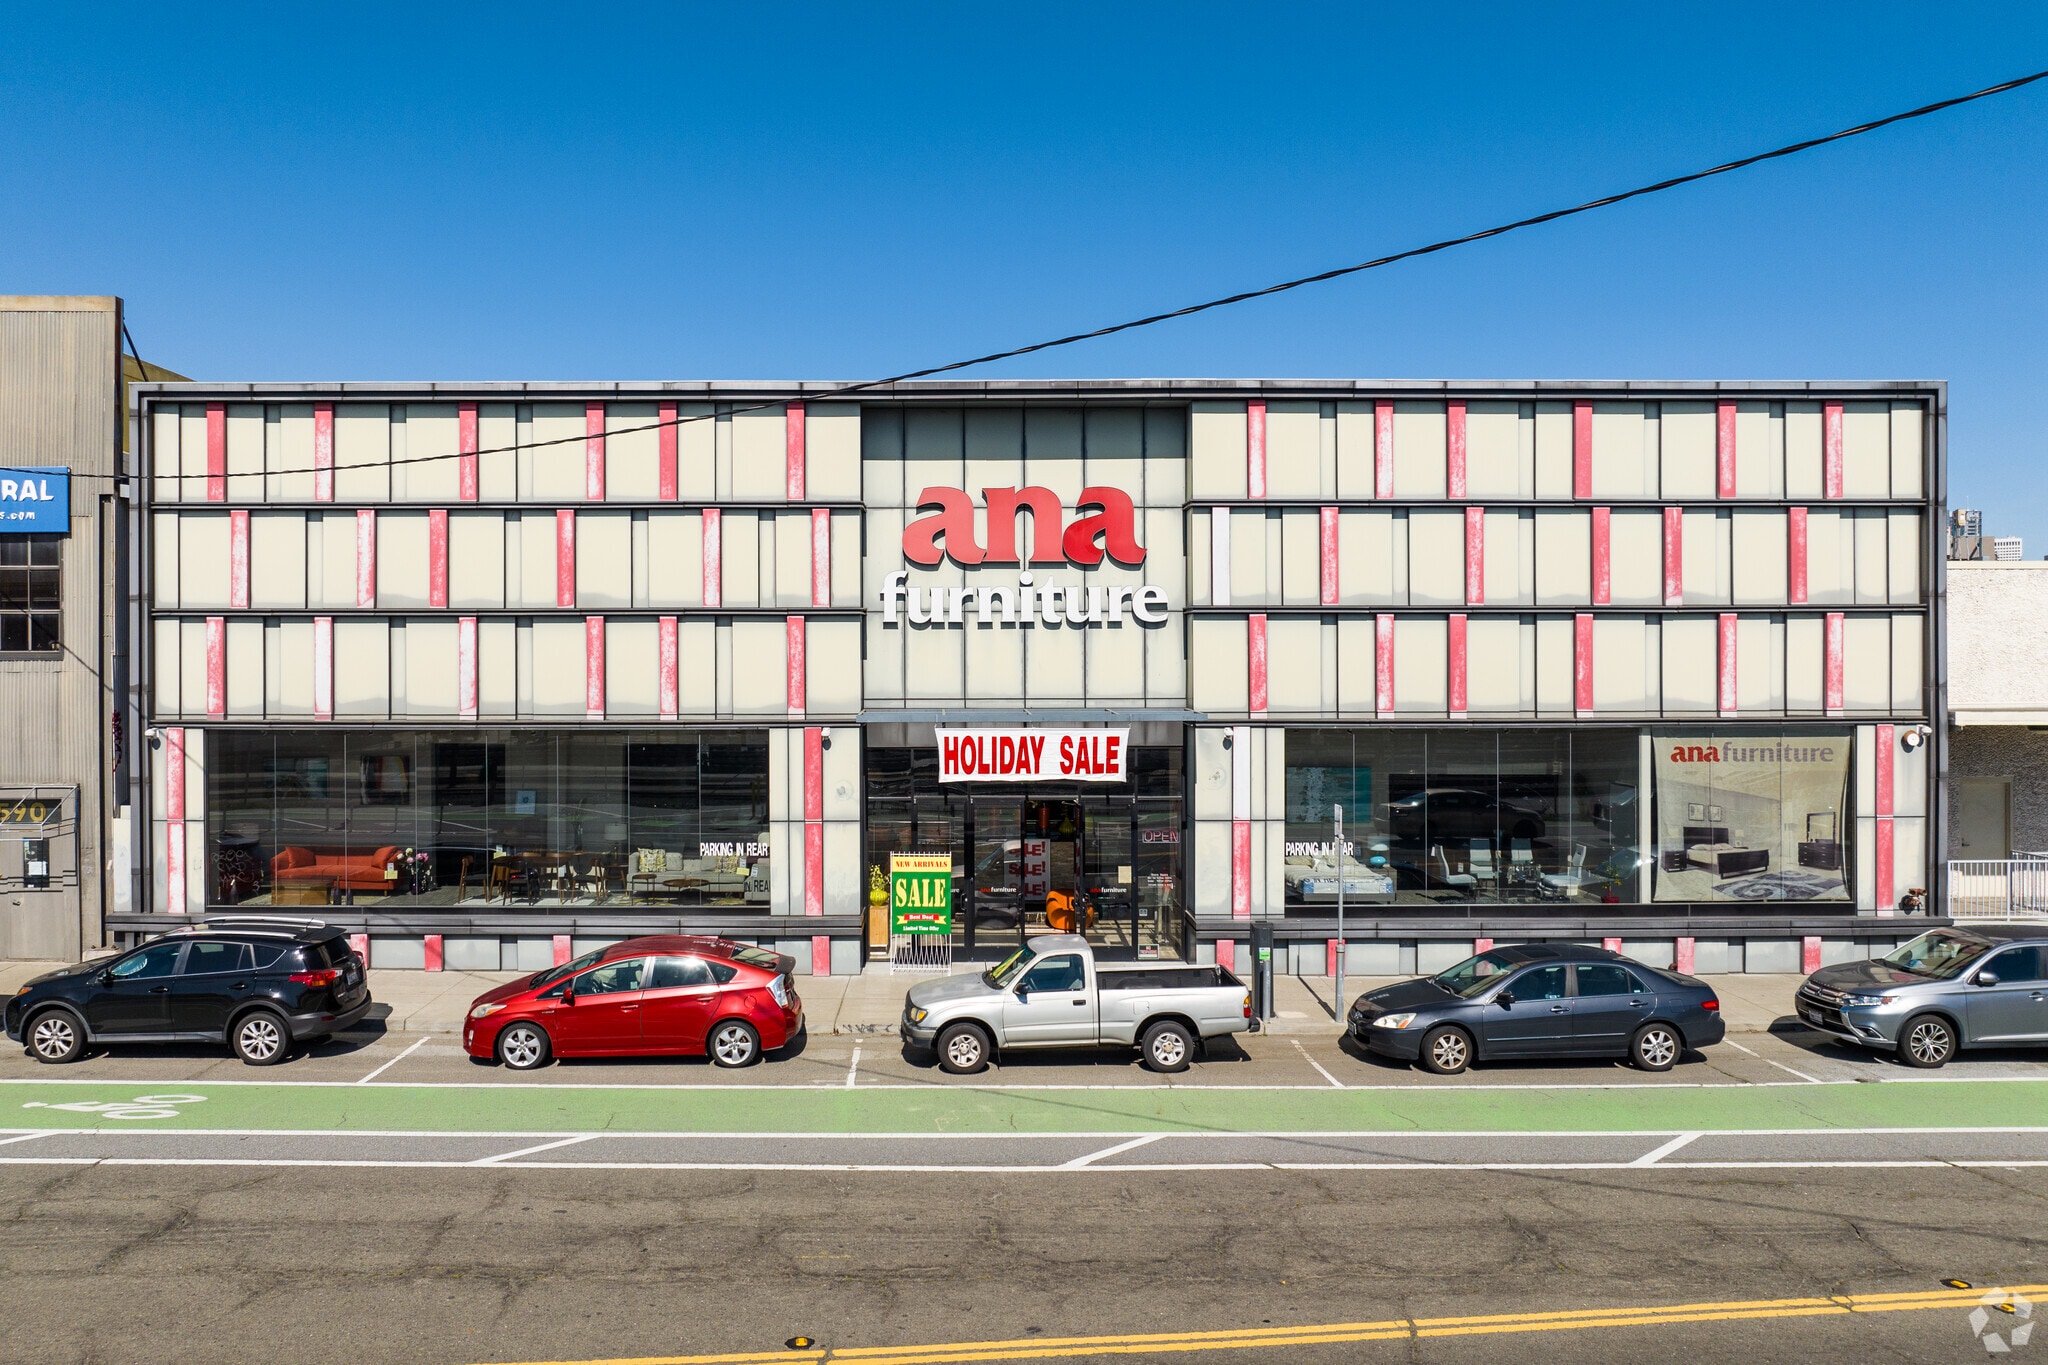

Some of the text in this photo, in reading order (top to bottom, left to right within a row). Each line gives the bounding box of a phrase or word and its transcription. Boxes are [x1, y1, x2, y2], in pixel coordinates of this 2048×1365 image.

[902, 486, 1147, 565] ana
[880, 570, 1169, 630] furniture
[943, 735, 1120, 775] HOLIDAY SALE
[1722, 741, 1834, 763] furniture
[1144, 829, 1179, 842] OPEN
[700, 842, 768, 857] PARKING IN REAR
[1285, 841, 1354, 856] PARKING IN RAR
[895, 860, 948, 868] NEW ARRIVALS
[895, 878, 946, 908] SALE
